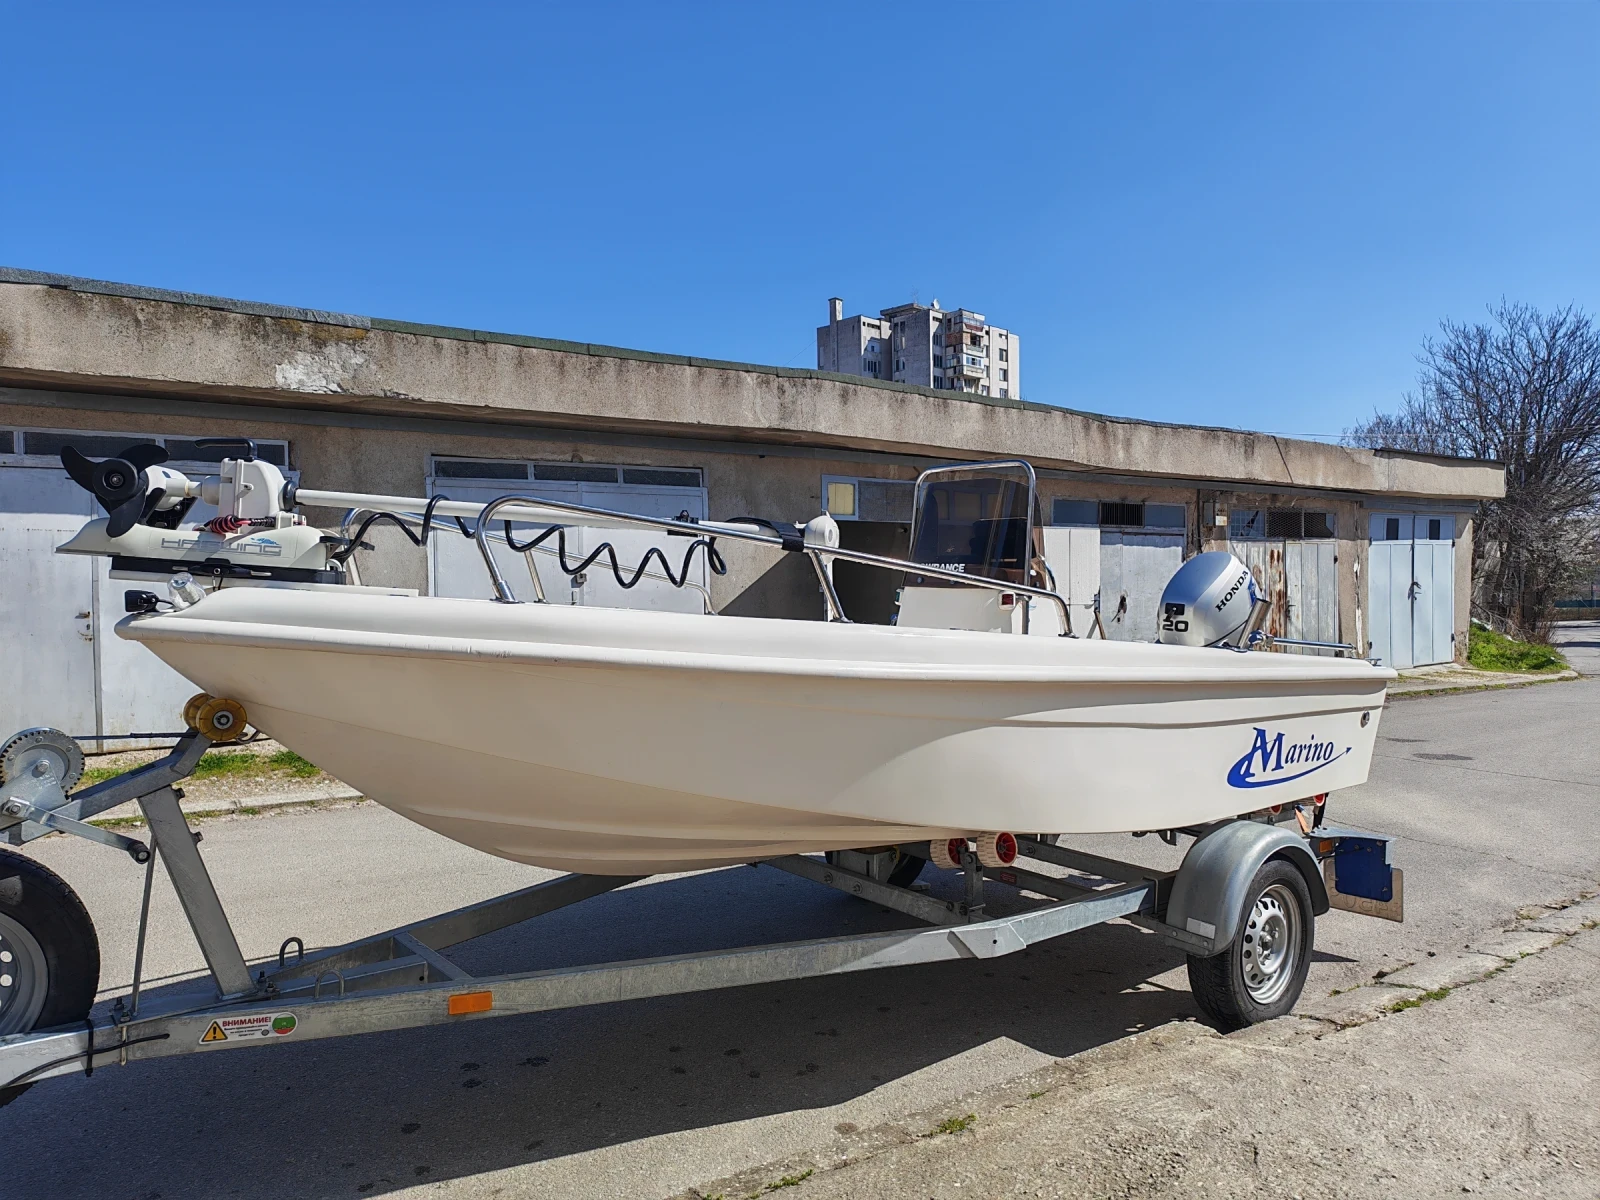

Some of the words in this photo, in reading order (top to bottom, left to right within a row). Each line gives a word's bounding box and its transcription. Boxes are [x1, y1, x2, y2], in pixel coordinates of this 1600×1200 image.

[1215, 570, 1249, 613] HONDA
[1162, 619, 1189, 633] 20
[222, 1016, 272, 1027] ВНИМАНИЕ!
